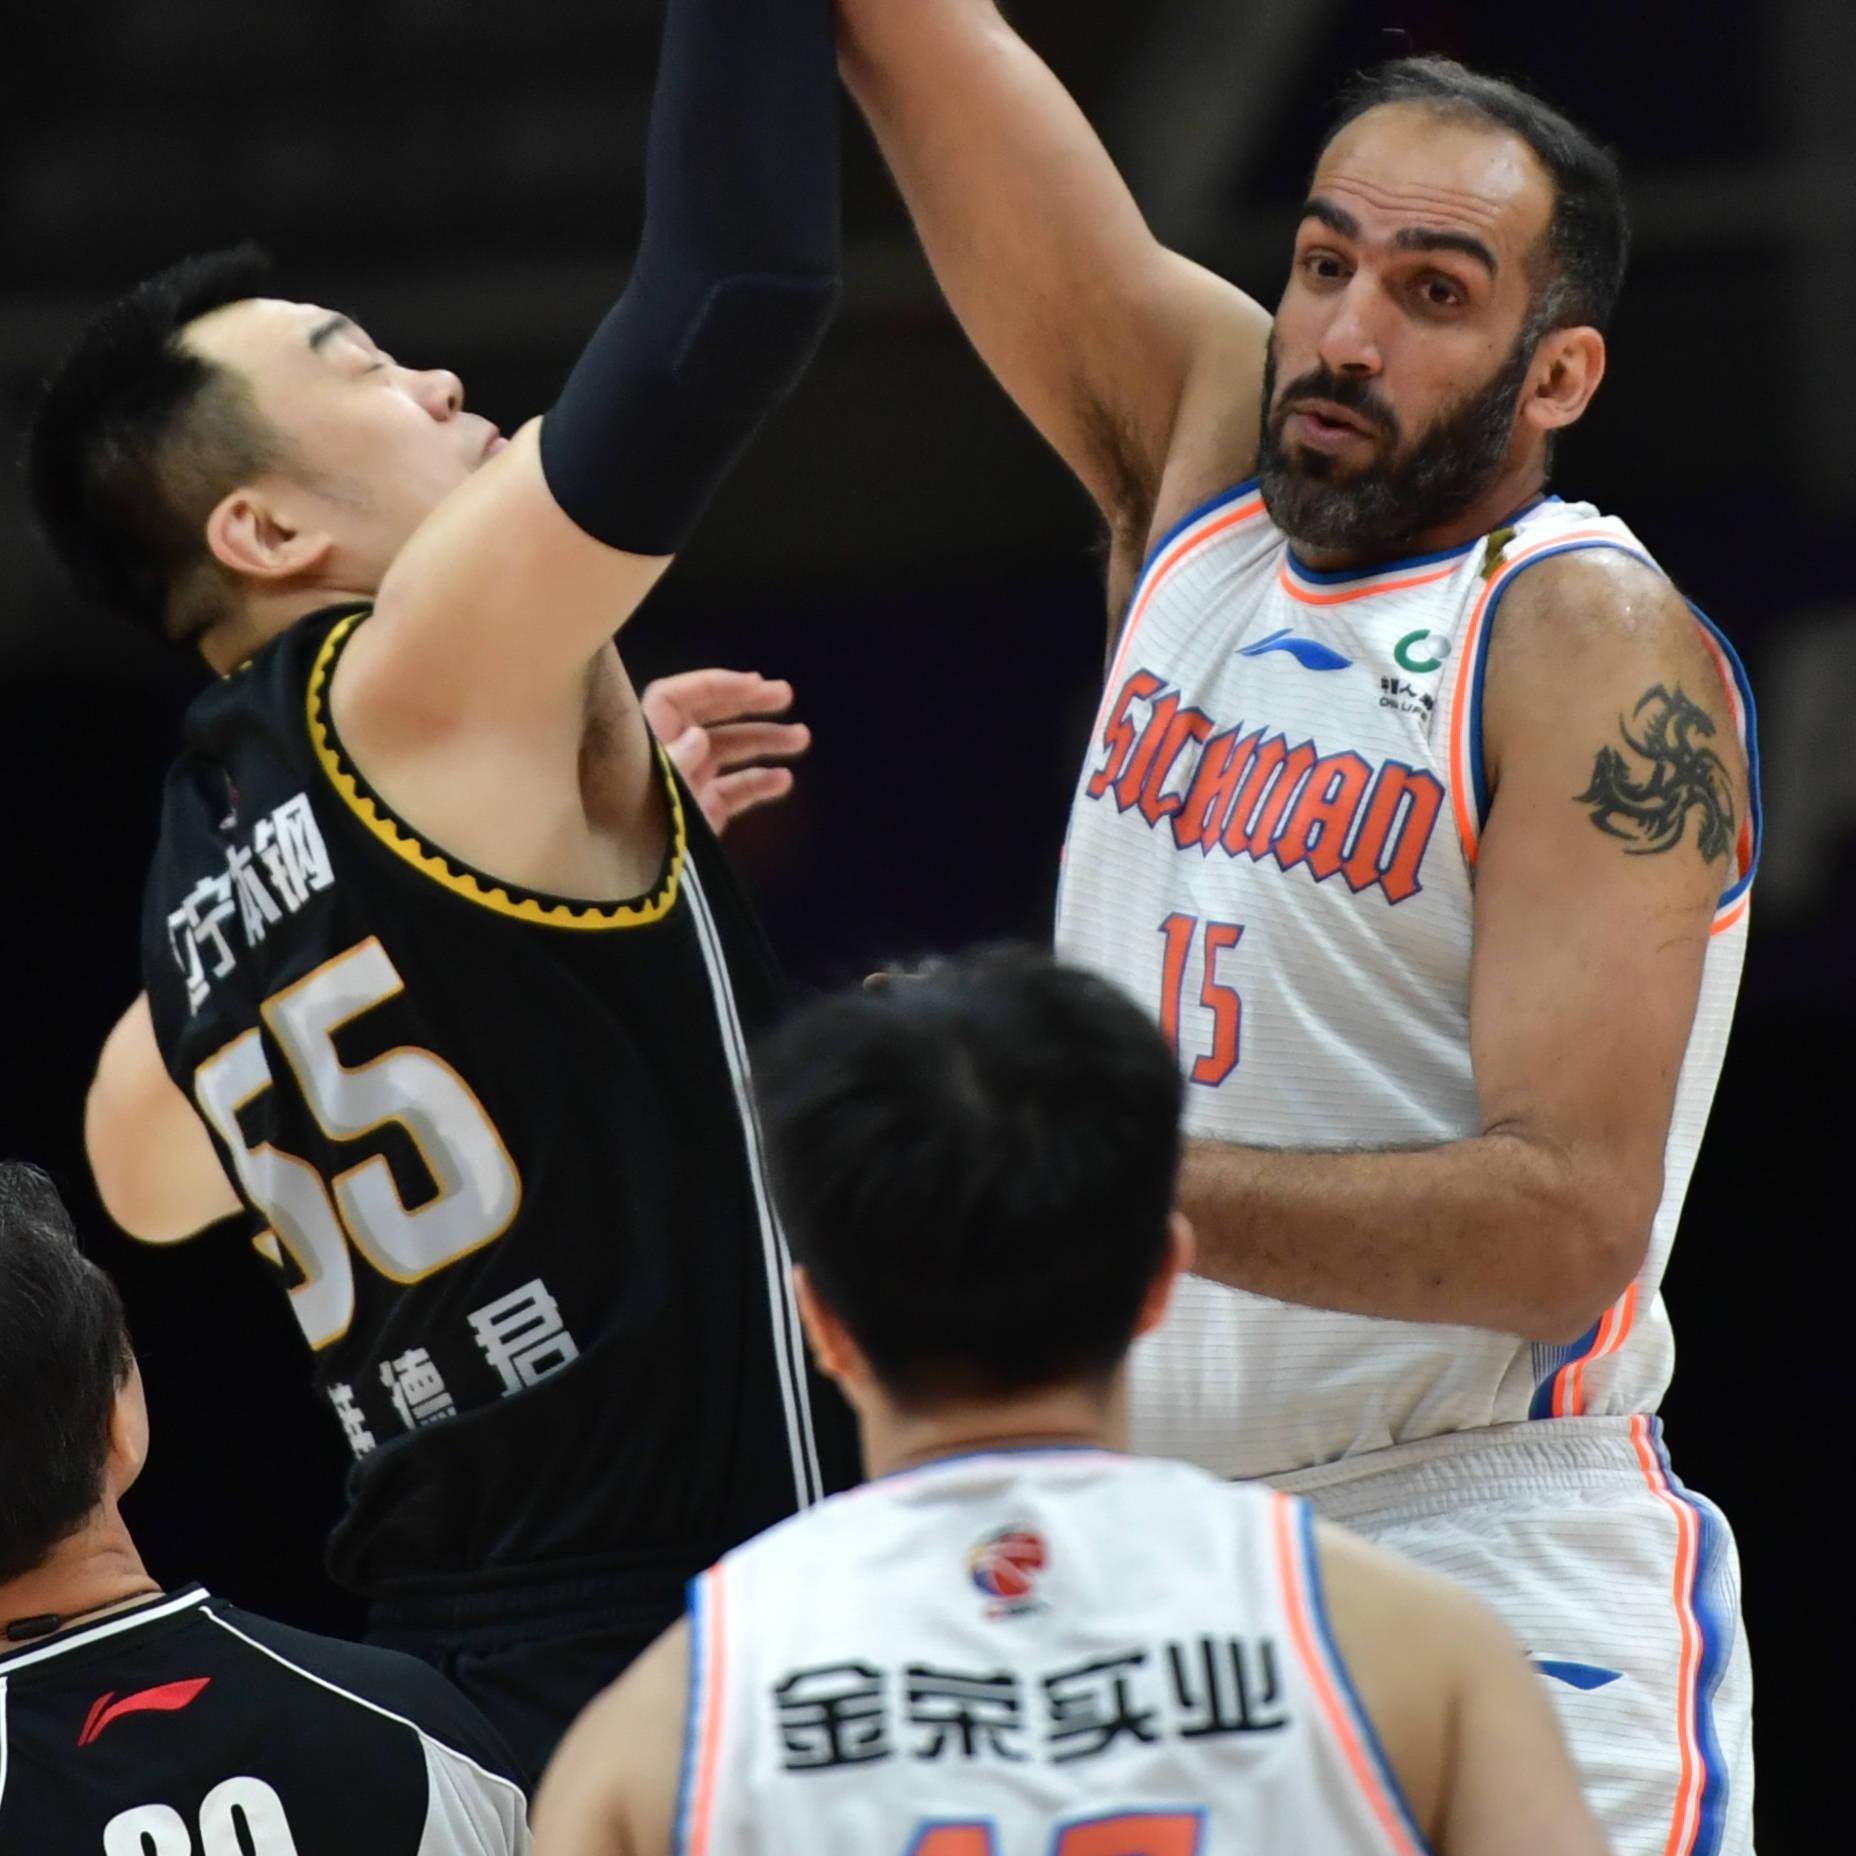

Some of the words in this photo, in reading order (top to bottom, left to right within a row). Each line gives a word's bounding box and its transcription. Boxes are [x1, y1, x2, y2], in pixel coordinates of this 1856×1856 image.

[1086, 668, 1445, 906] SICHUAN
[1158, 911, 1245, 1088] 15
[195, 935, 523, 1352] 55
[773, 1633, 1288, 1771] 金荣实业
